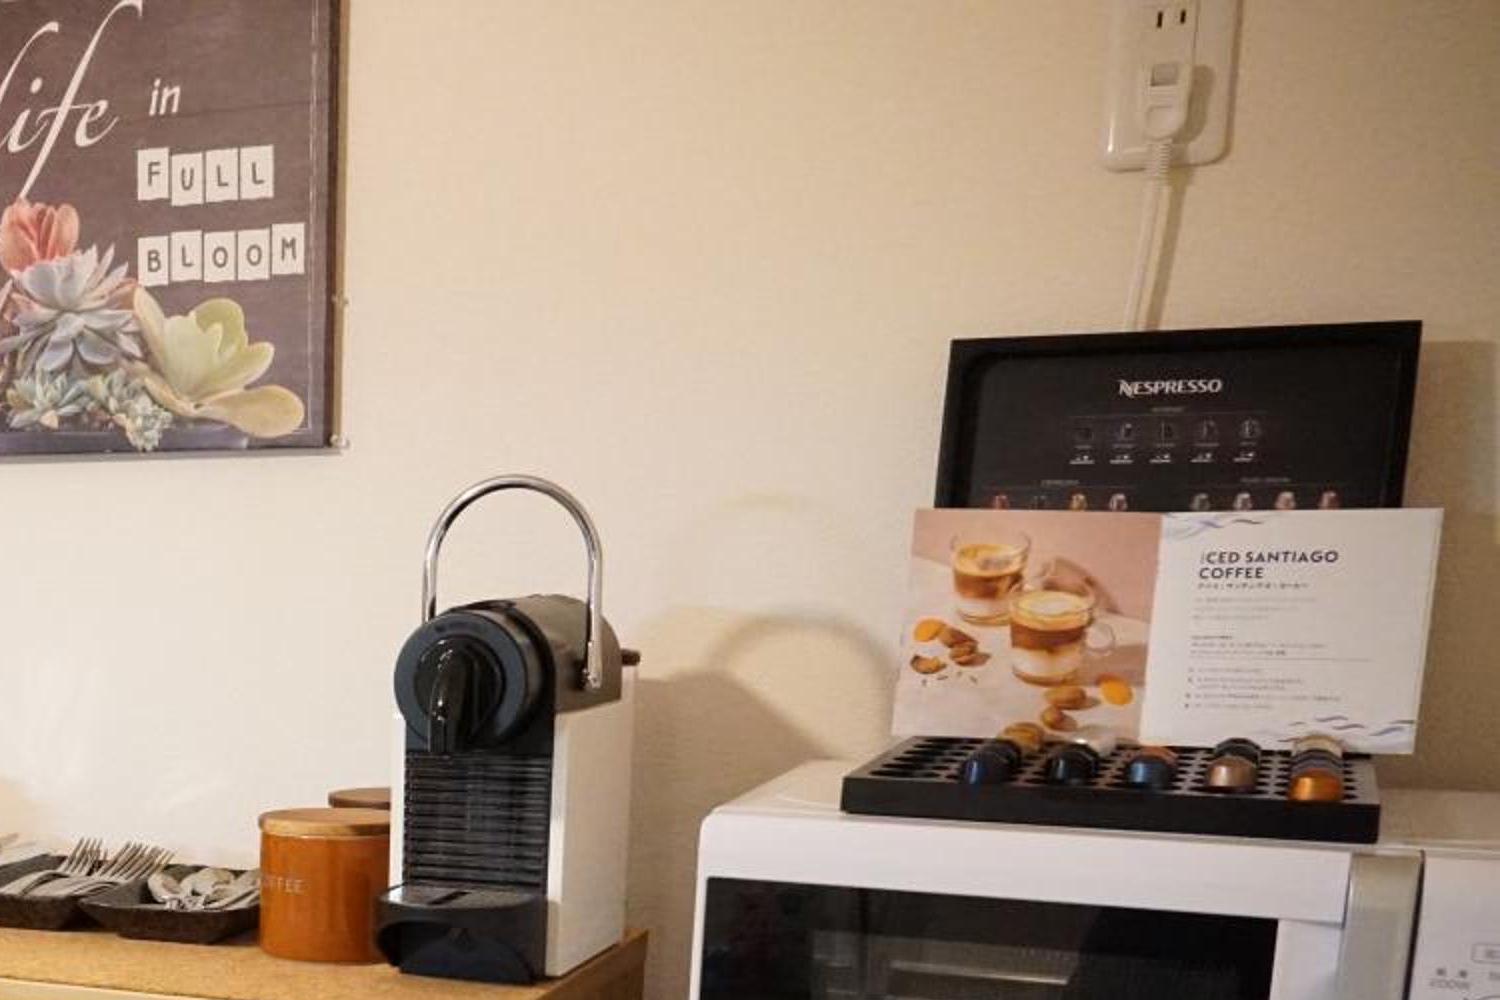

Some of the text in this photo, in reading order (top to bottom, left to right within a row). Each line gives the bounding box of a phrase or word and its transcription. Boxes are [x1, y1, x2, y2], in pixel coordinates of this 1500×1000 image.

[148, 79, 181, 117] in
[145, 160, 266, 192] FULL
[145, 235, 299, 275] BLOOM
[1118, 379, 1223, 399] NESPRESSO
[1245, 550, 1339, 564] SANTIAGO
[1198, 567, 1264, 580] COFFEE
